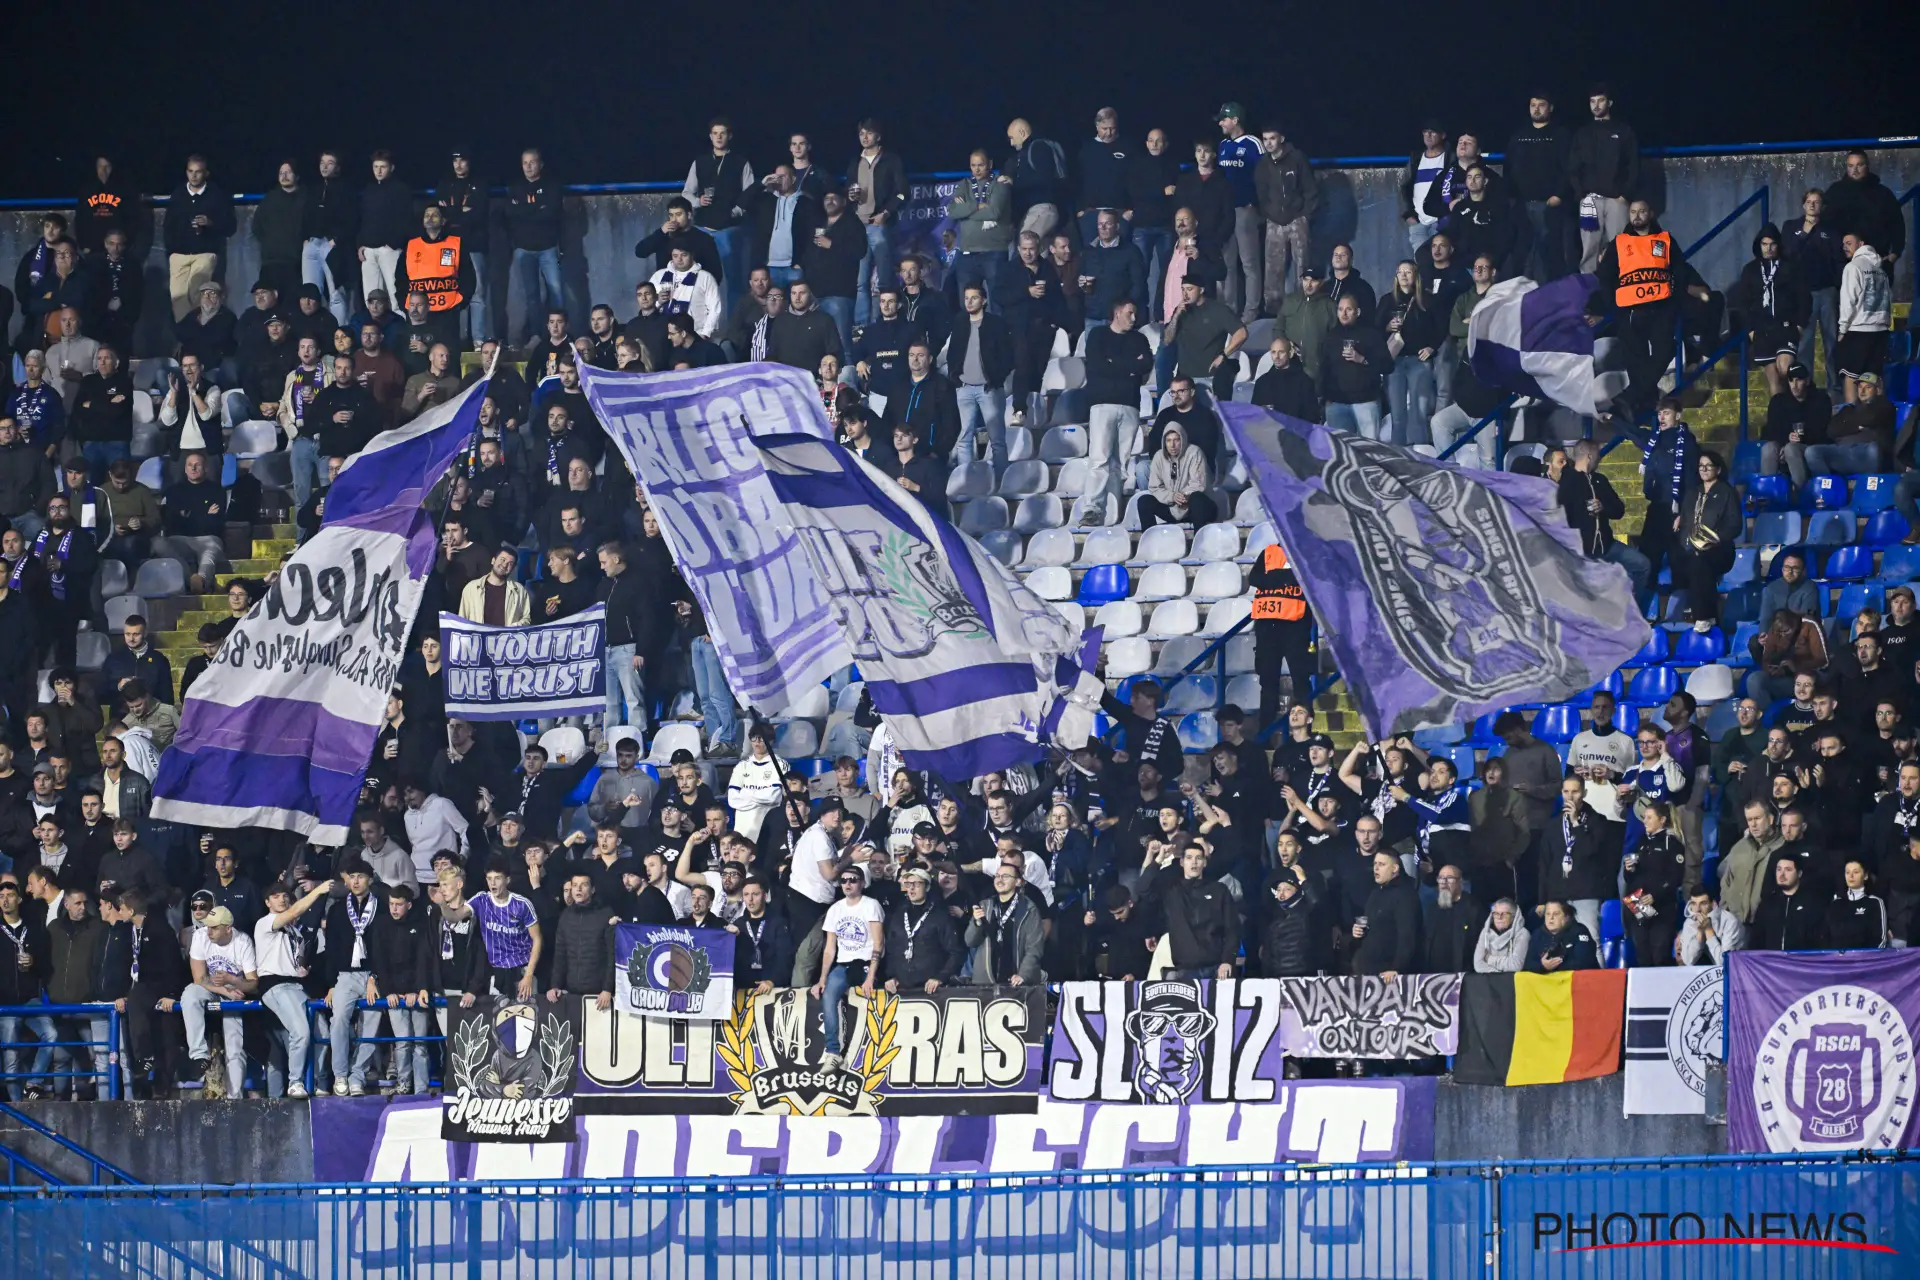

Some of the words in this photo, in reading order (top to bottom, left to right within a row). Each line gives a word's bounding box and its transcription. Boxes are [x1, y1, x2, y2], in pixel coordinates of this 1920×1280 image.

[409, 280, 459, 291] STEWARD
[1636, 284, 1661, 298] 047
[450, 632, 482, 666] IN
[486, 624, 599, 665] YOUTH
[449, 668, 492, 700] WE
[495, 659, 600, 699] TRUST
[1579, 753, 1617, 764] sunweb
[1145, 985, 1168, 999] SOUTH
[1168, 985, 1196, 999] LEADERS
[1282, 974, 1457, 1028] VANDALS
[1680, 973, 1713, 1006] PURPLE
[1763, 992, 1908, 1065] SUPPORTERSCLUB
[887, 999, 1028, 1087] RAS
[1815, 1035, 1861, 1051] RSCA
[756, 1071, 859, 1097] Brussels
[1675, 1057, 1692, 1085] RSCA
[1822, 1078, 1846, 1101] 28
[448, 1086, 570, 1125] Jeunesse
[1761, 1101, 1780, 1132] DE
[466, 1118, 513, 1135] Mauves
[515, 1120, 550, 1138] Army
[1821, 1125, 1847, 1136] OLEN
